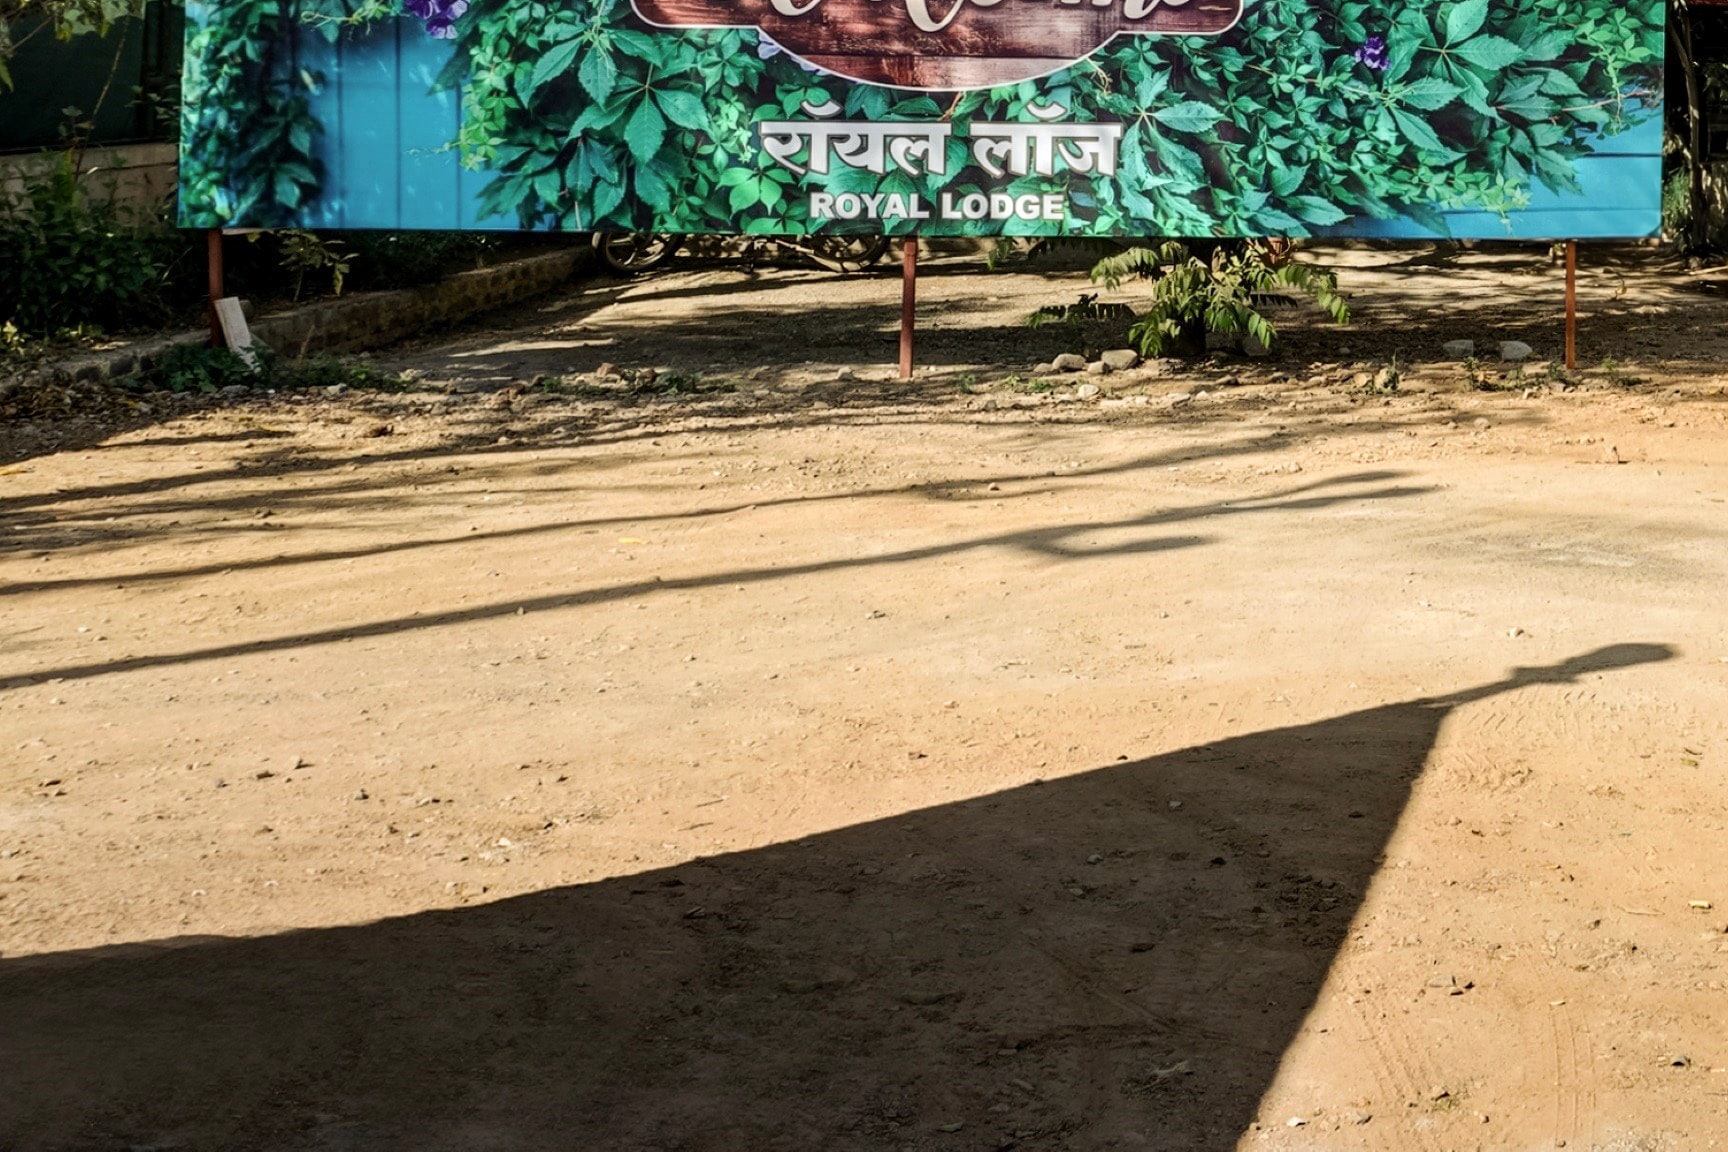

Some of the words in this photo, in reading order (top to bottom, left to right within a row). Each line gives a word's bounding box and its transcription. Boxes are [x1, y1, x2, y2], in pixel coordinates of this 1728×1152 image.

[760, 98, 951, 176] रॉयल
[969, 99, 1122, 178] लॉज
[810, 192, 930, 219] ROYAL
[942, 192, 1065, 220] LODGE
